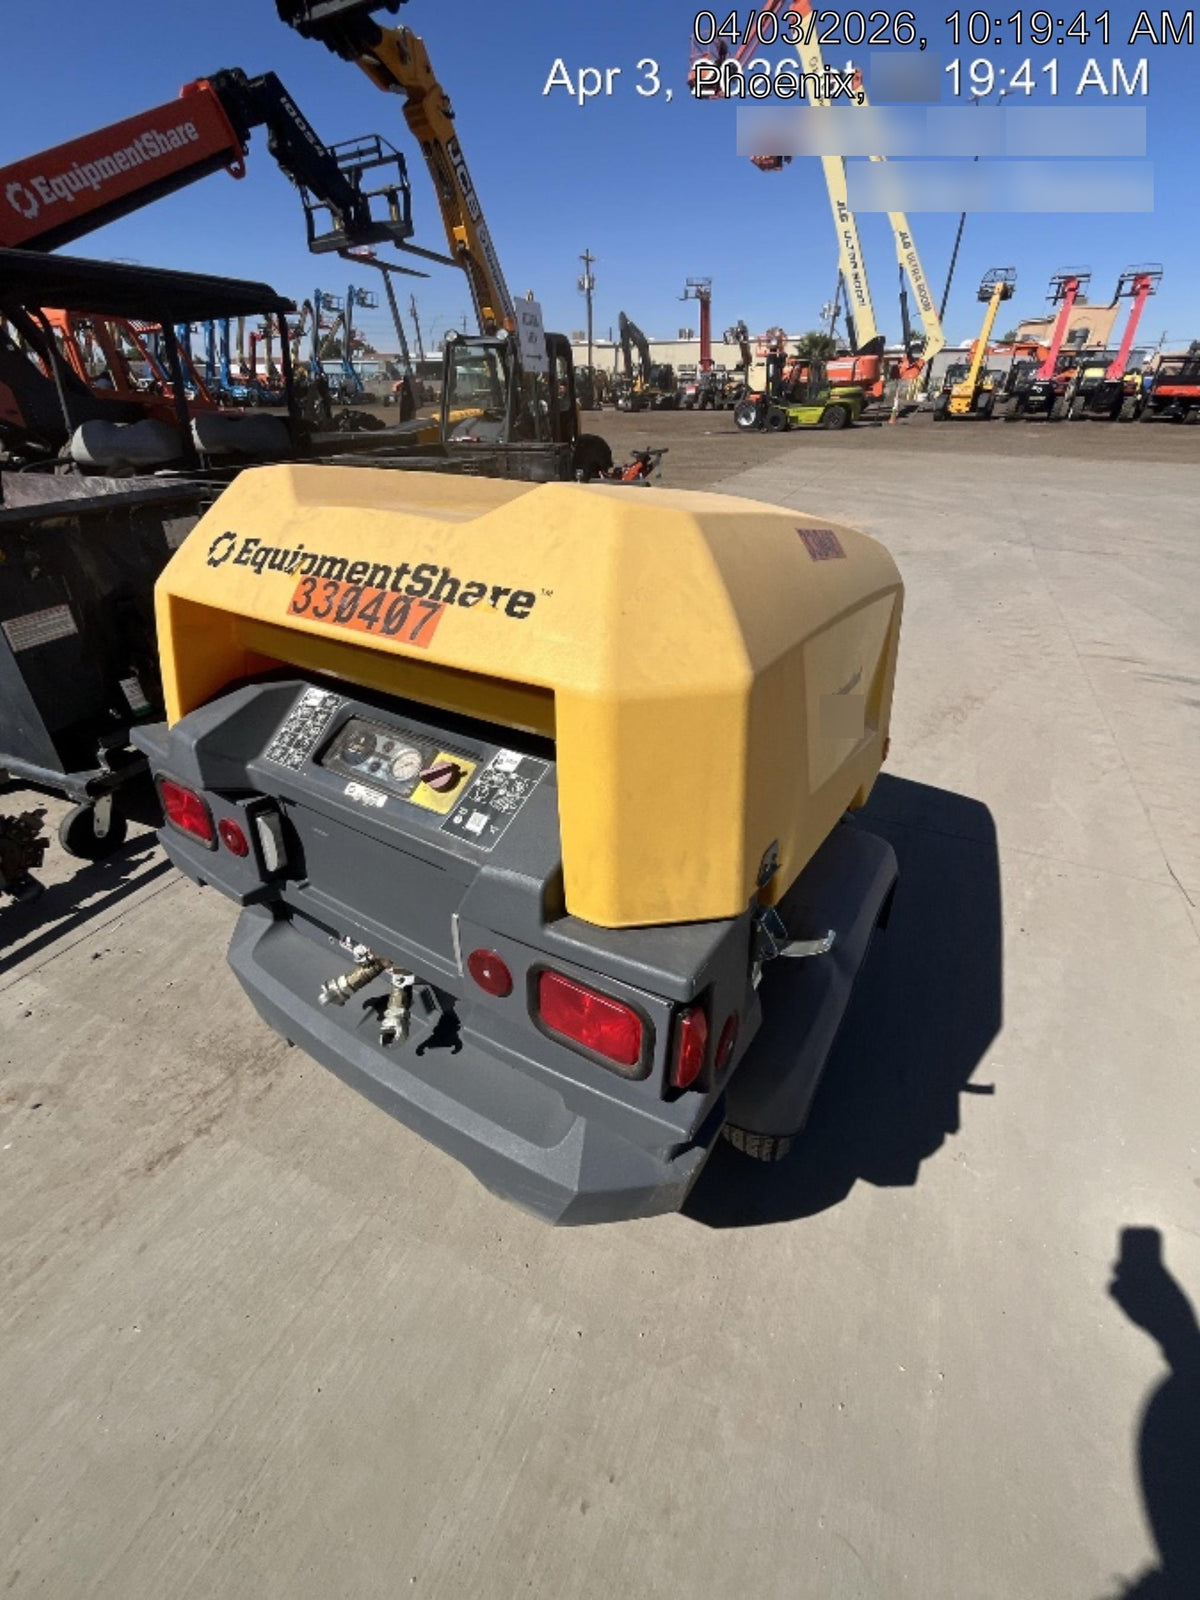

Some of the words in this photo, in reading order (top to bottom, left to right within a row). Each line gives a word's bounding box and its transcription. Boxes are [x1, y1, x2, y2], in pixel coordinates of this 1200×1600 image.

[31, 119, 199, 206] EquipmentShare
[447, 140, 480, 221] JCB
[837, 201, 849, 222] JLG
[899, 231, 911, 250] JLG
[906, 252, 922, 283] ULTRA
[917, 284, 932, 312] BOOM
[233, 537, 536, 620] EquipmentShare
[291, 576, 442, 642] 330407
